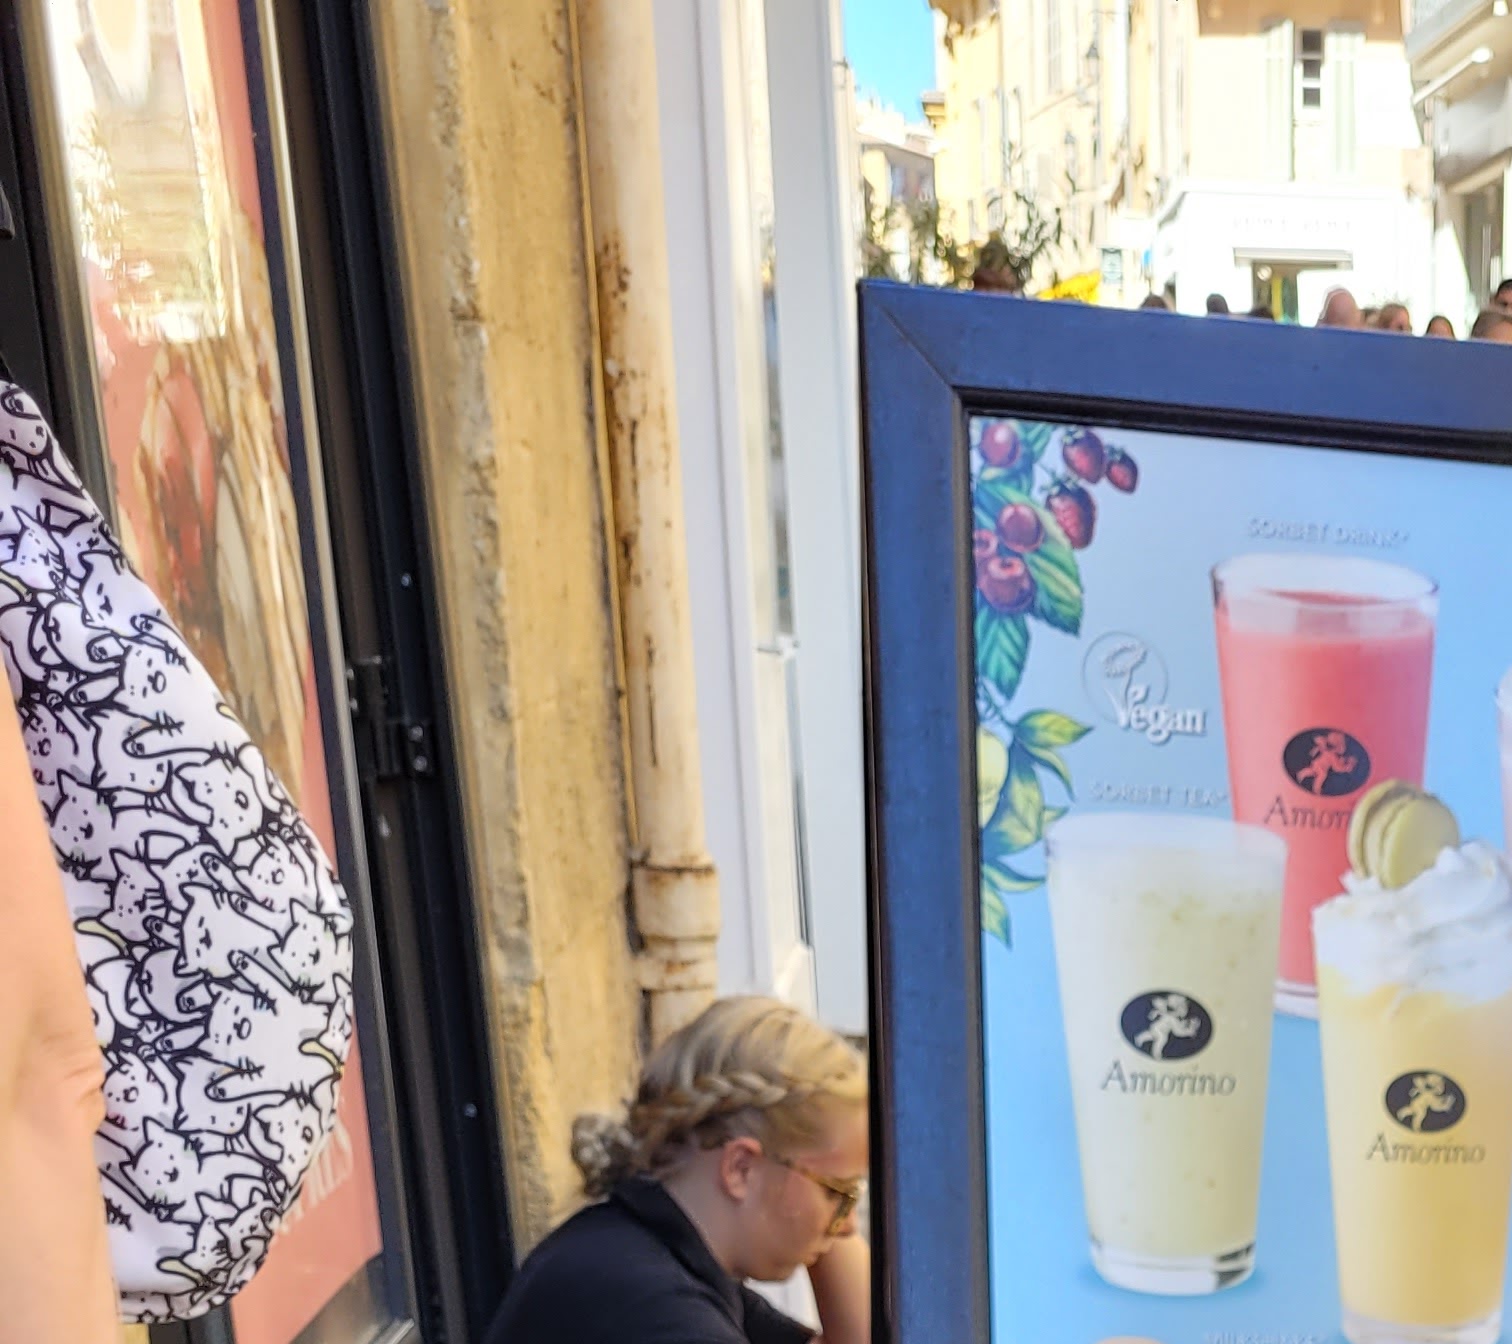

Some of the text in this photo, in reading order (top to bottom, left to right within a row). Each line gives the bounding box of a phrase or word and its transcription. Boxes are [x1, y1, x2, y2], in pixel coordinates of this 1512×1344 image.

[1104, 678, 1207, 745] Vegan
[1263, 795, 1350, 830] Amor
[1101, 1059, 1238, 1097] Amorino
[1366, 1131, 1487, 1165] Amorino
